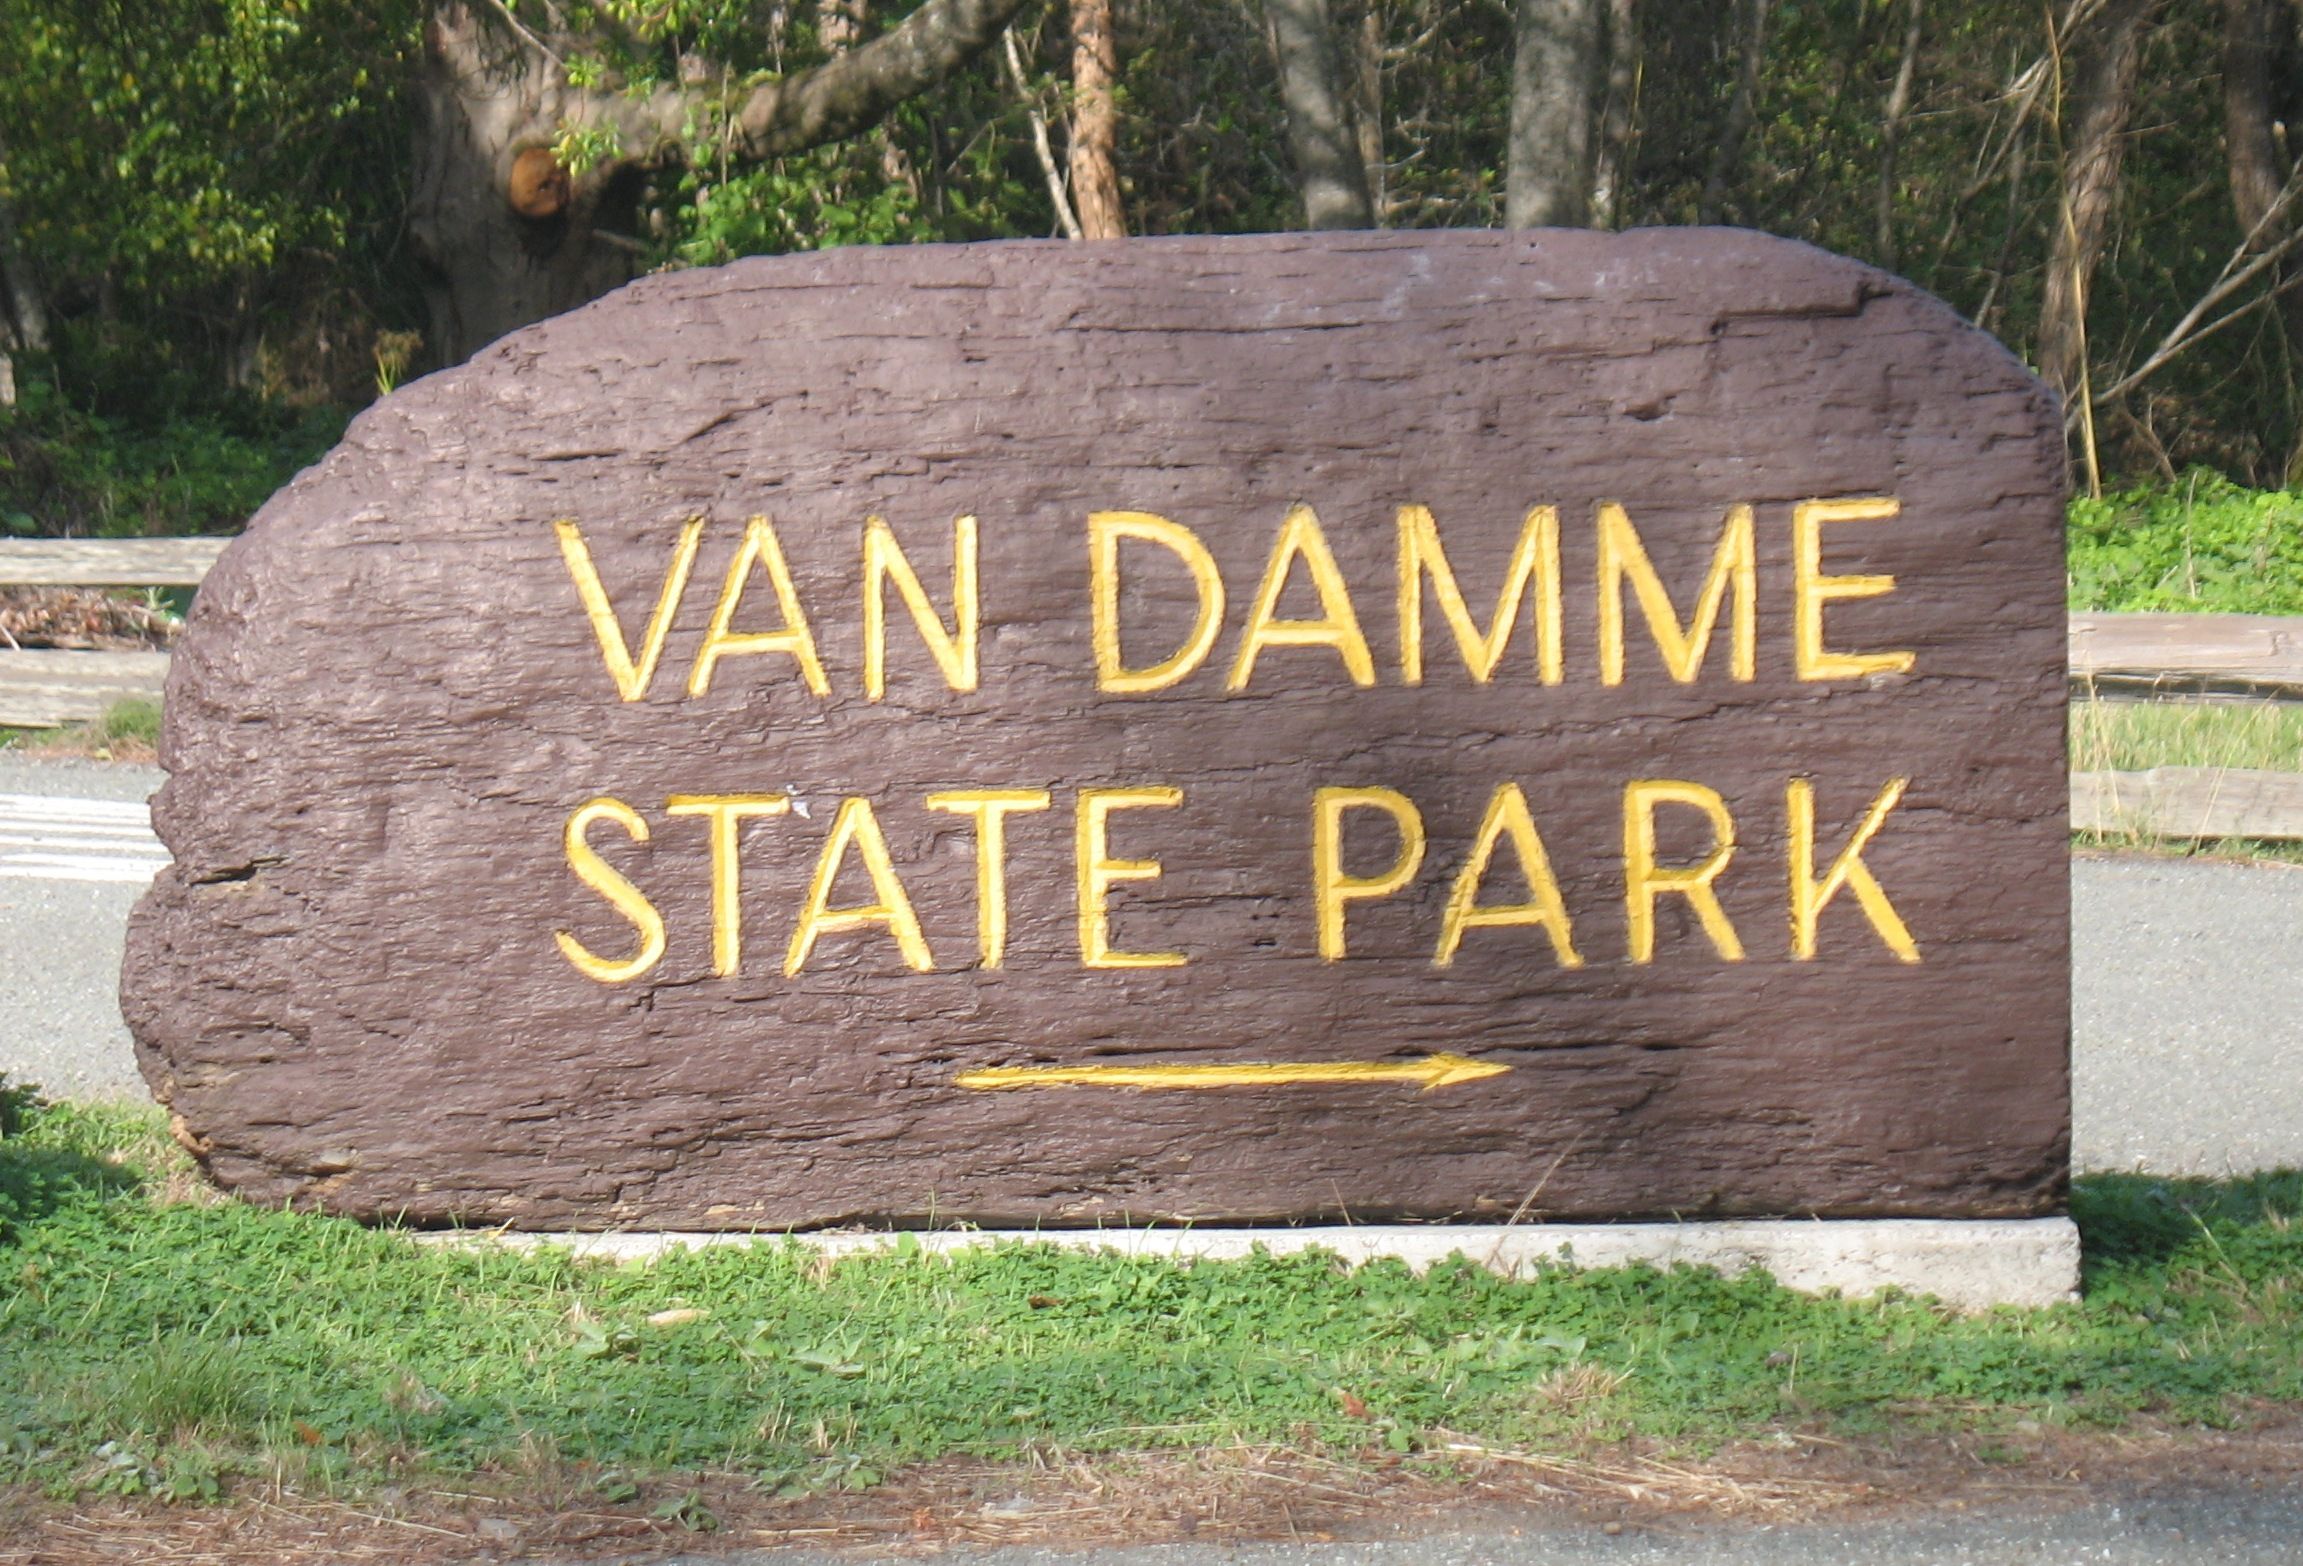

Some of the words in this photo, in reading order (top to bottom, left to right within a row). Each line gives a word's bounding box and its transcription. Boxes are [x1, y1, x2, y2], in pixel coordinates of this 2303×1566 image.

[554, 514, 980, 702] VAN
[1087, 497, 1917, 694] DAMME
[554, 786, 1189, 983] STATE
[1311, 776, 1922, 968] PARK
